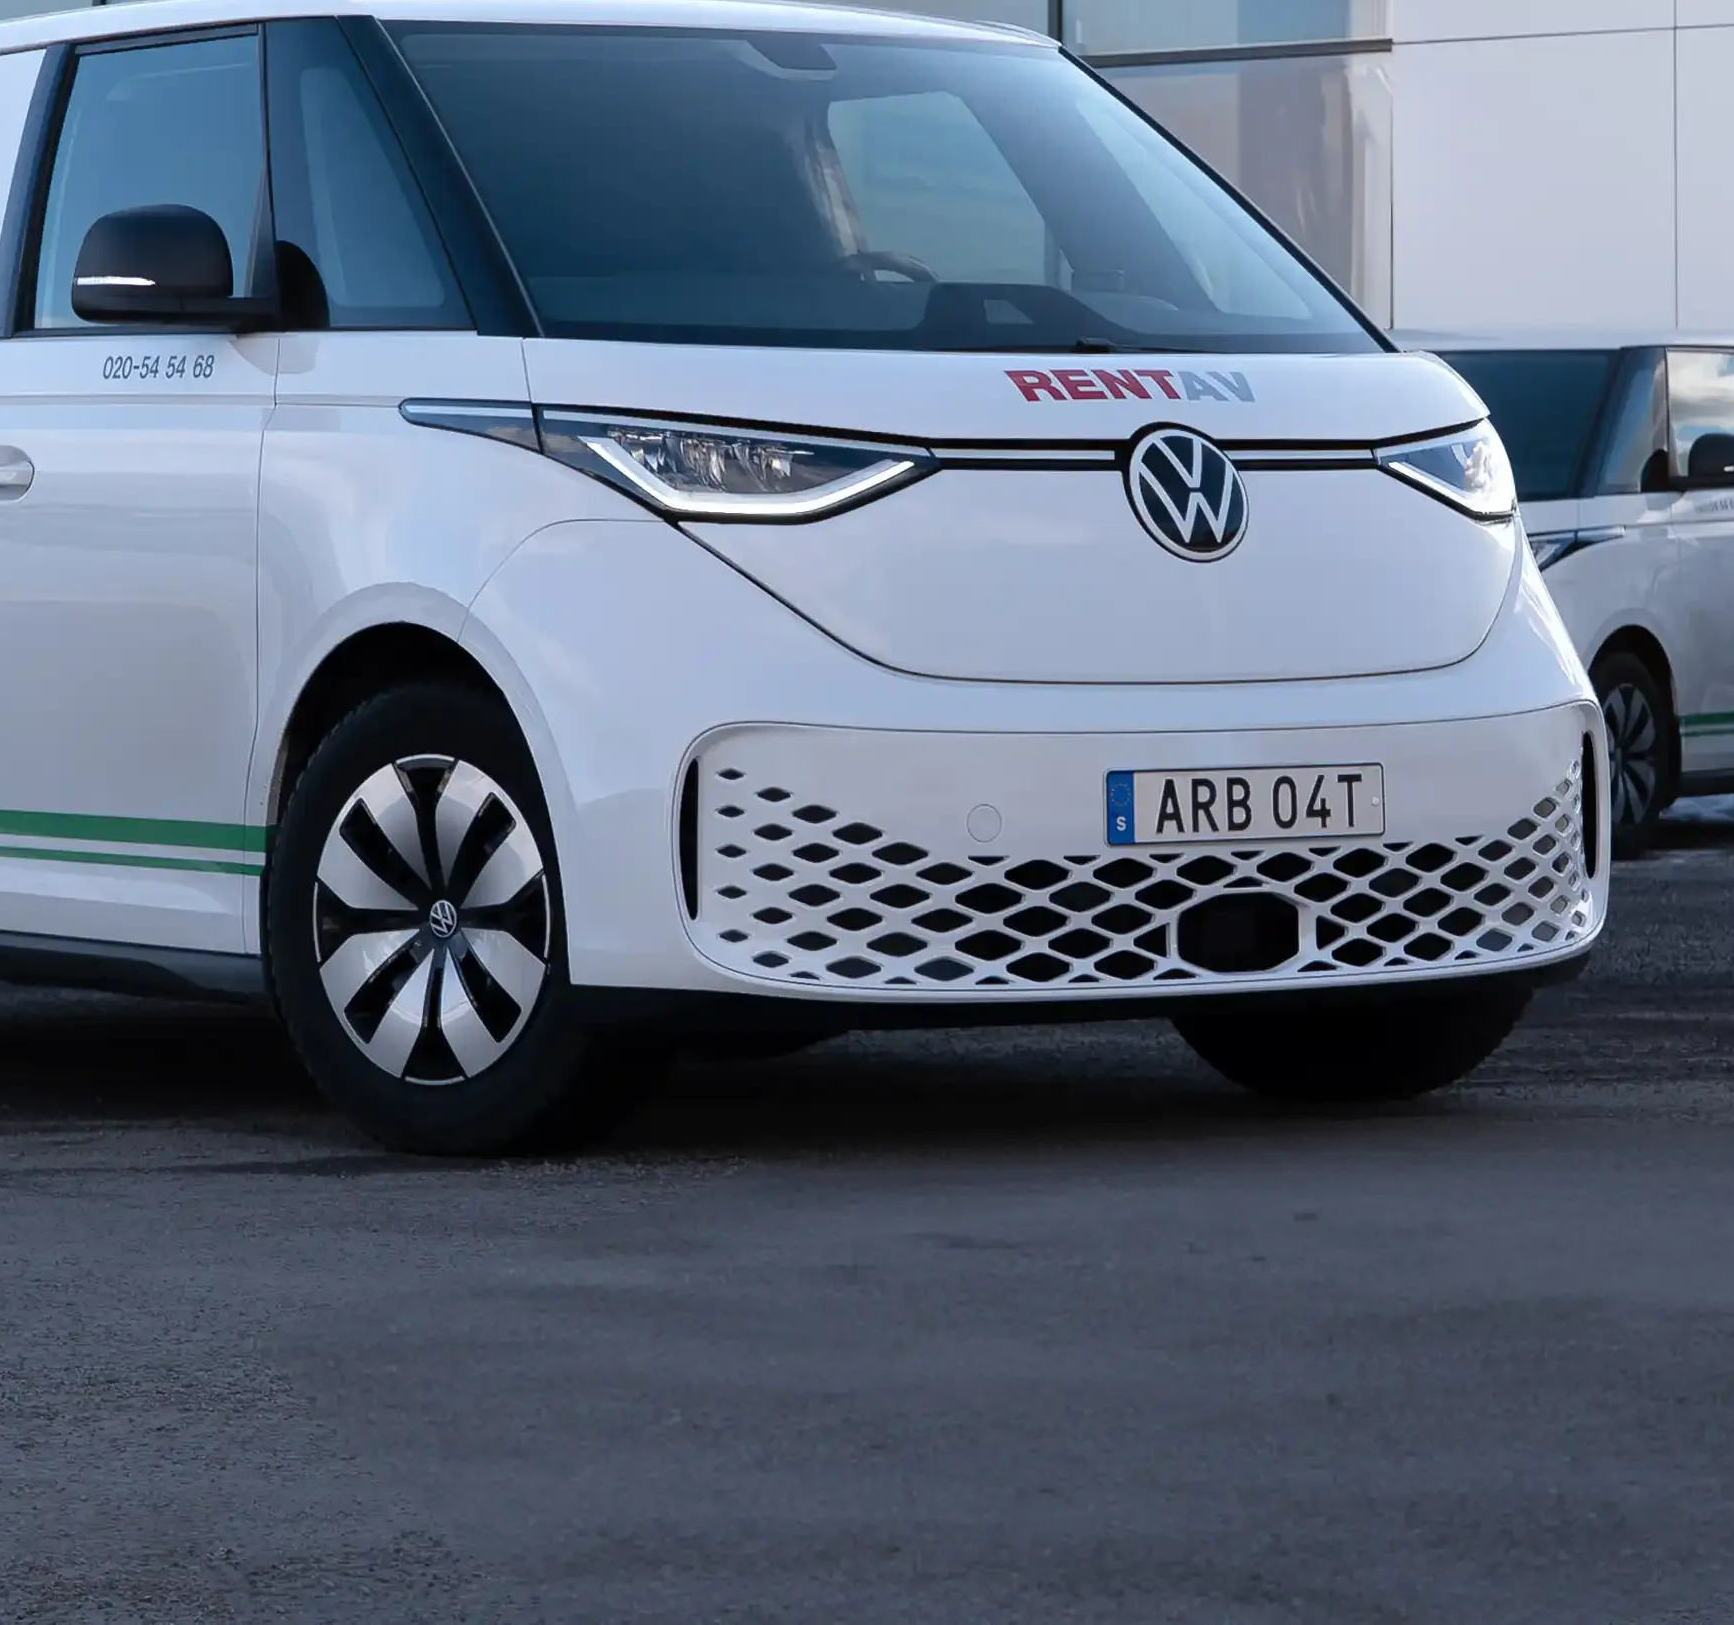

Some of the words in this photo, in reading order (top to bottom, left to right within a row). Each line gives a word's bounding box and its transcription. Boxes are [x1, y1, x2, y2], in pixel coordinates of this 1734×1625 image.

[103, 355, 160, 380] 020-54
[165, 355, 187, 379] 54
[193, 354, 215, 379] 68
[1004, 369, 1256, 403] RENTAV
[1155, 777, 1253, 835] ARB
[1272, 773, 1363, 830] 04T
[1116, 816, 1127, 832] S
